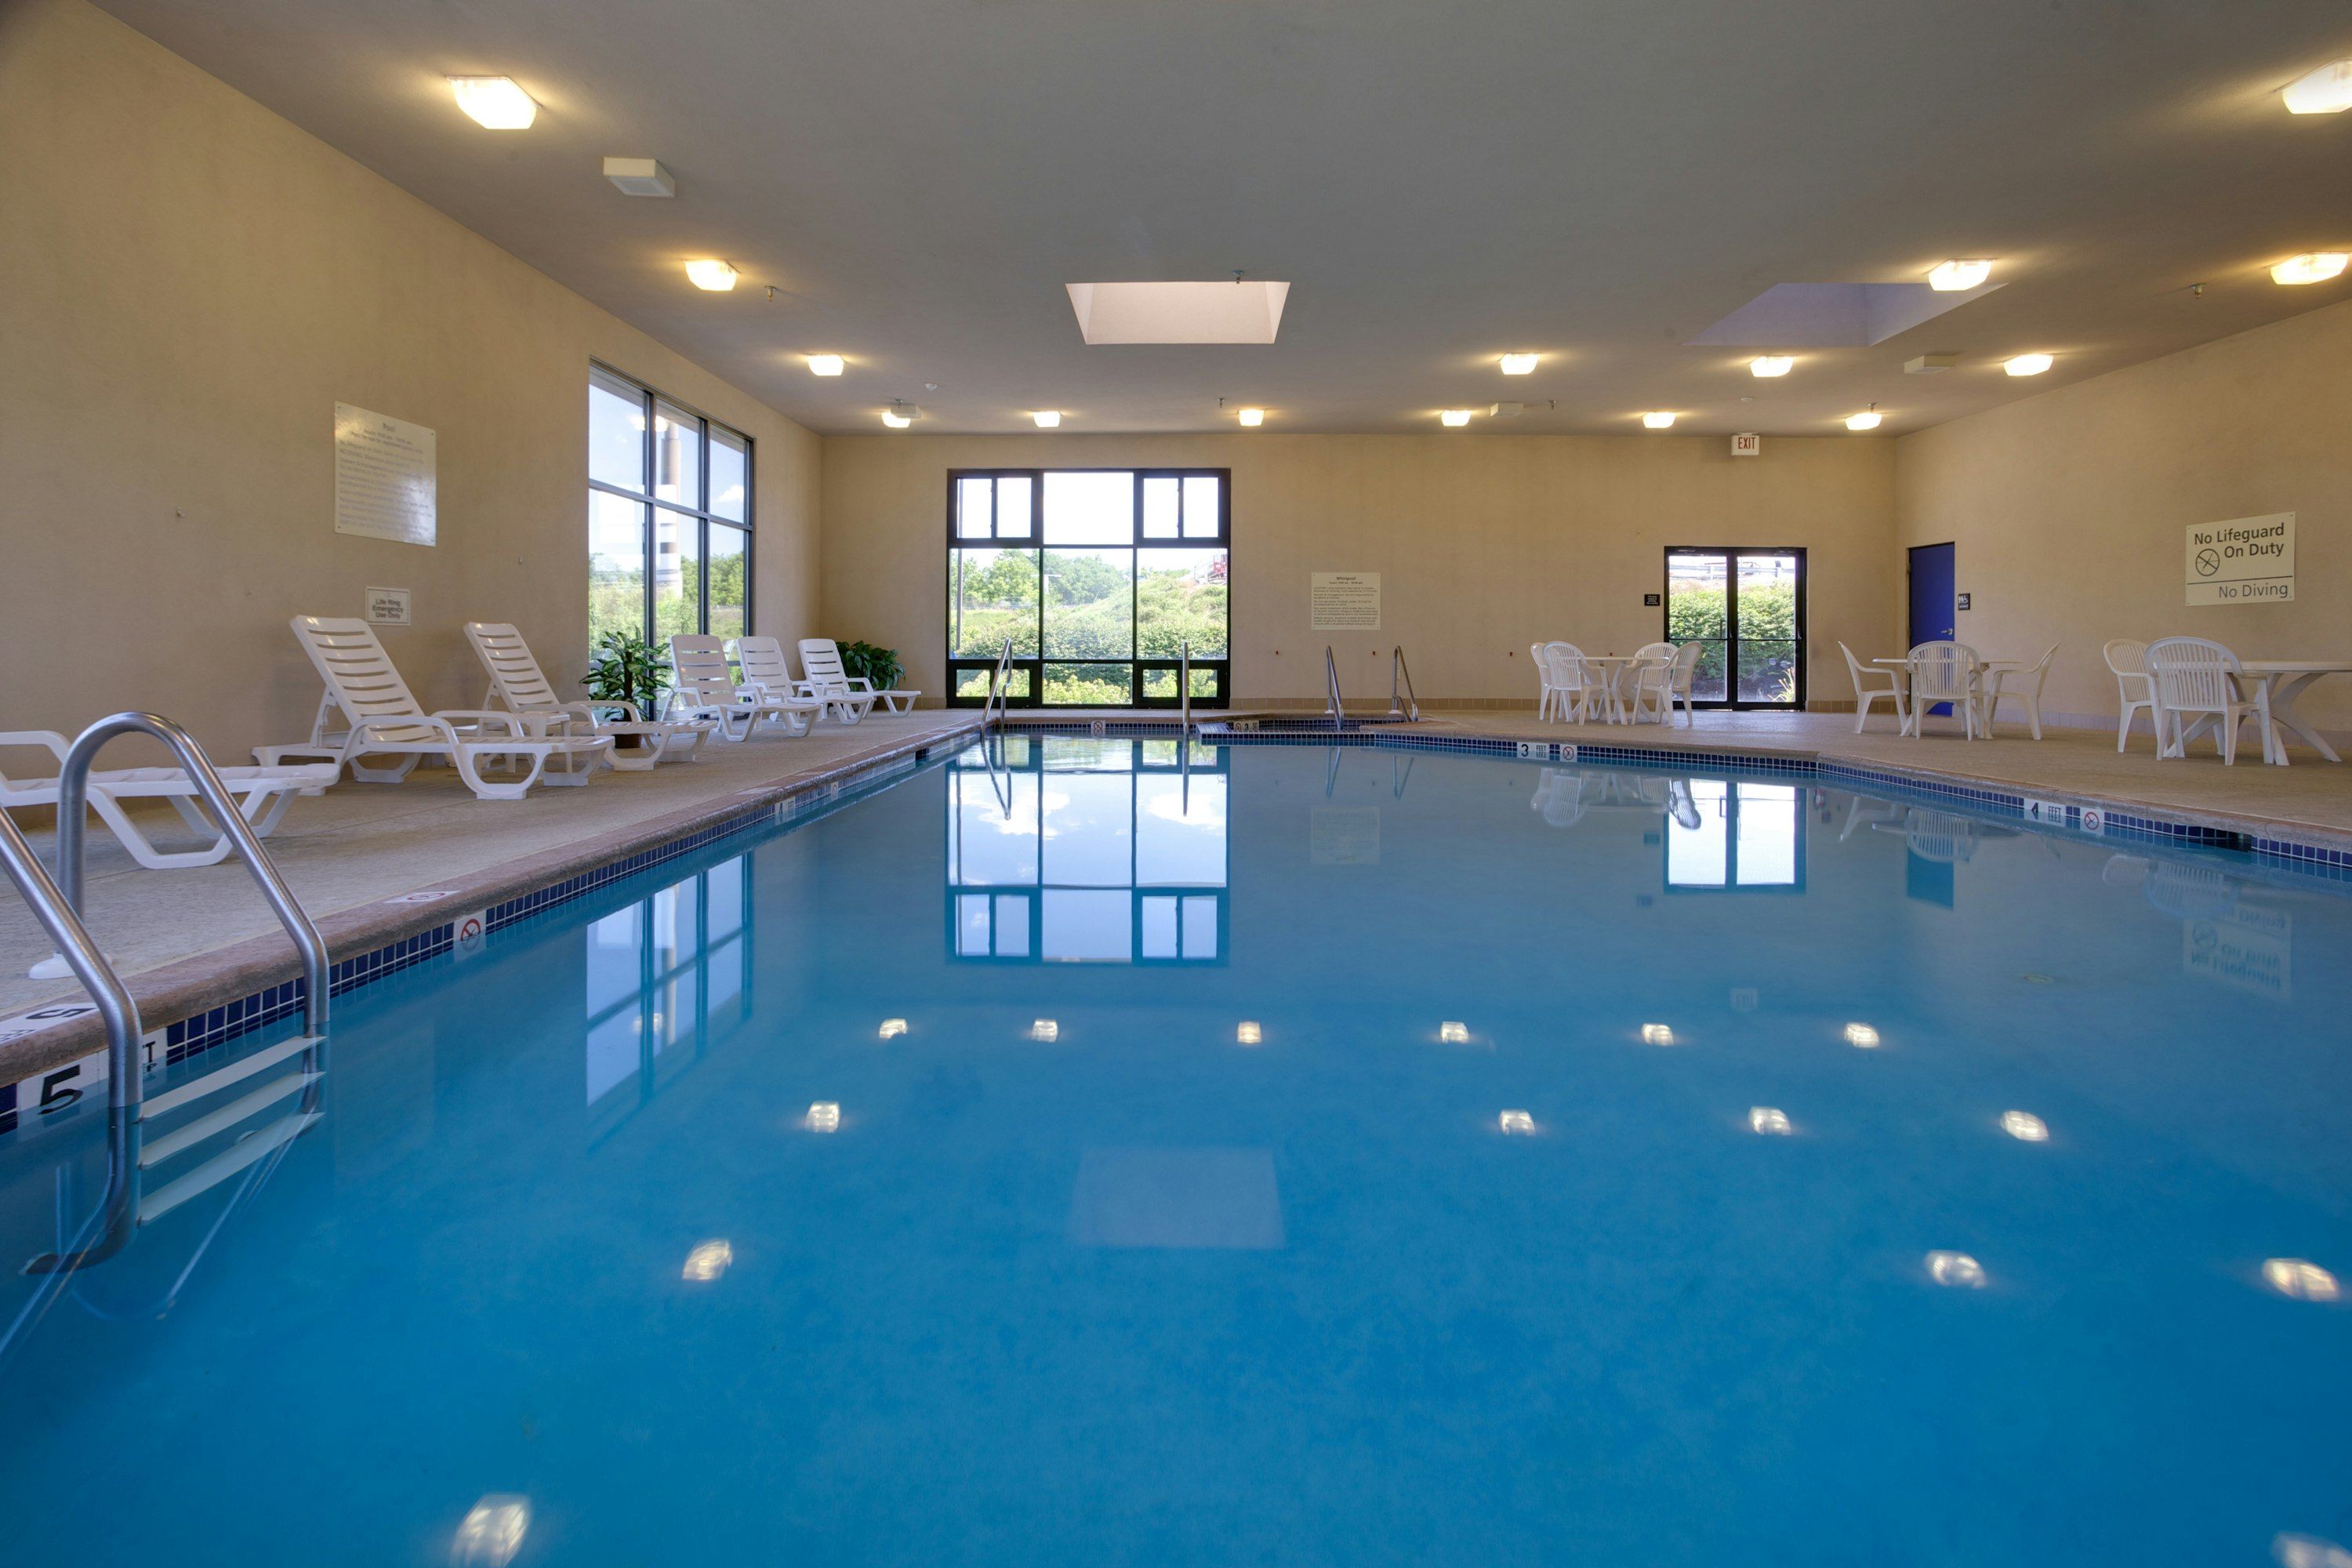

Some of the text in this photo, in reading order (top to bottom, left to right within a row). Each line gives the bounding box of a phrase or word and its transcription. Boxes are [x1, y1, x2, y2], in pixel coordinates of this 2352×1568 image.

[1738, 437, 1755, 449] EXIT
[2194, 522, 2285, 545] No Lifeguard
[2224, 543, 2285, 558] On Duty
[2219, 583, 2288, 598] No Diving
[372, 604, 404, 613] Emergency
[1522, 744, 1528, 755] 3
[38, 1064, 84, 1115] 5
